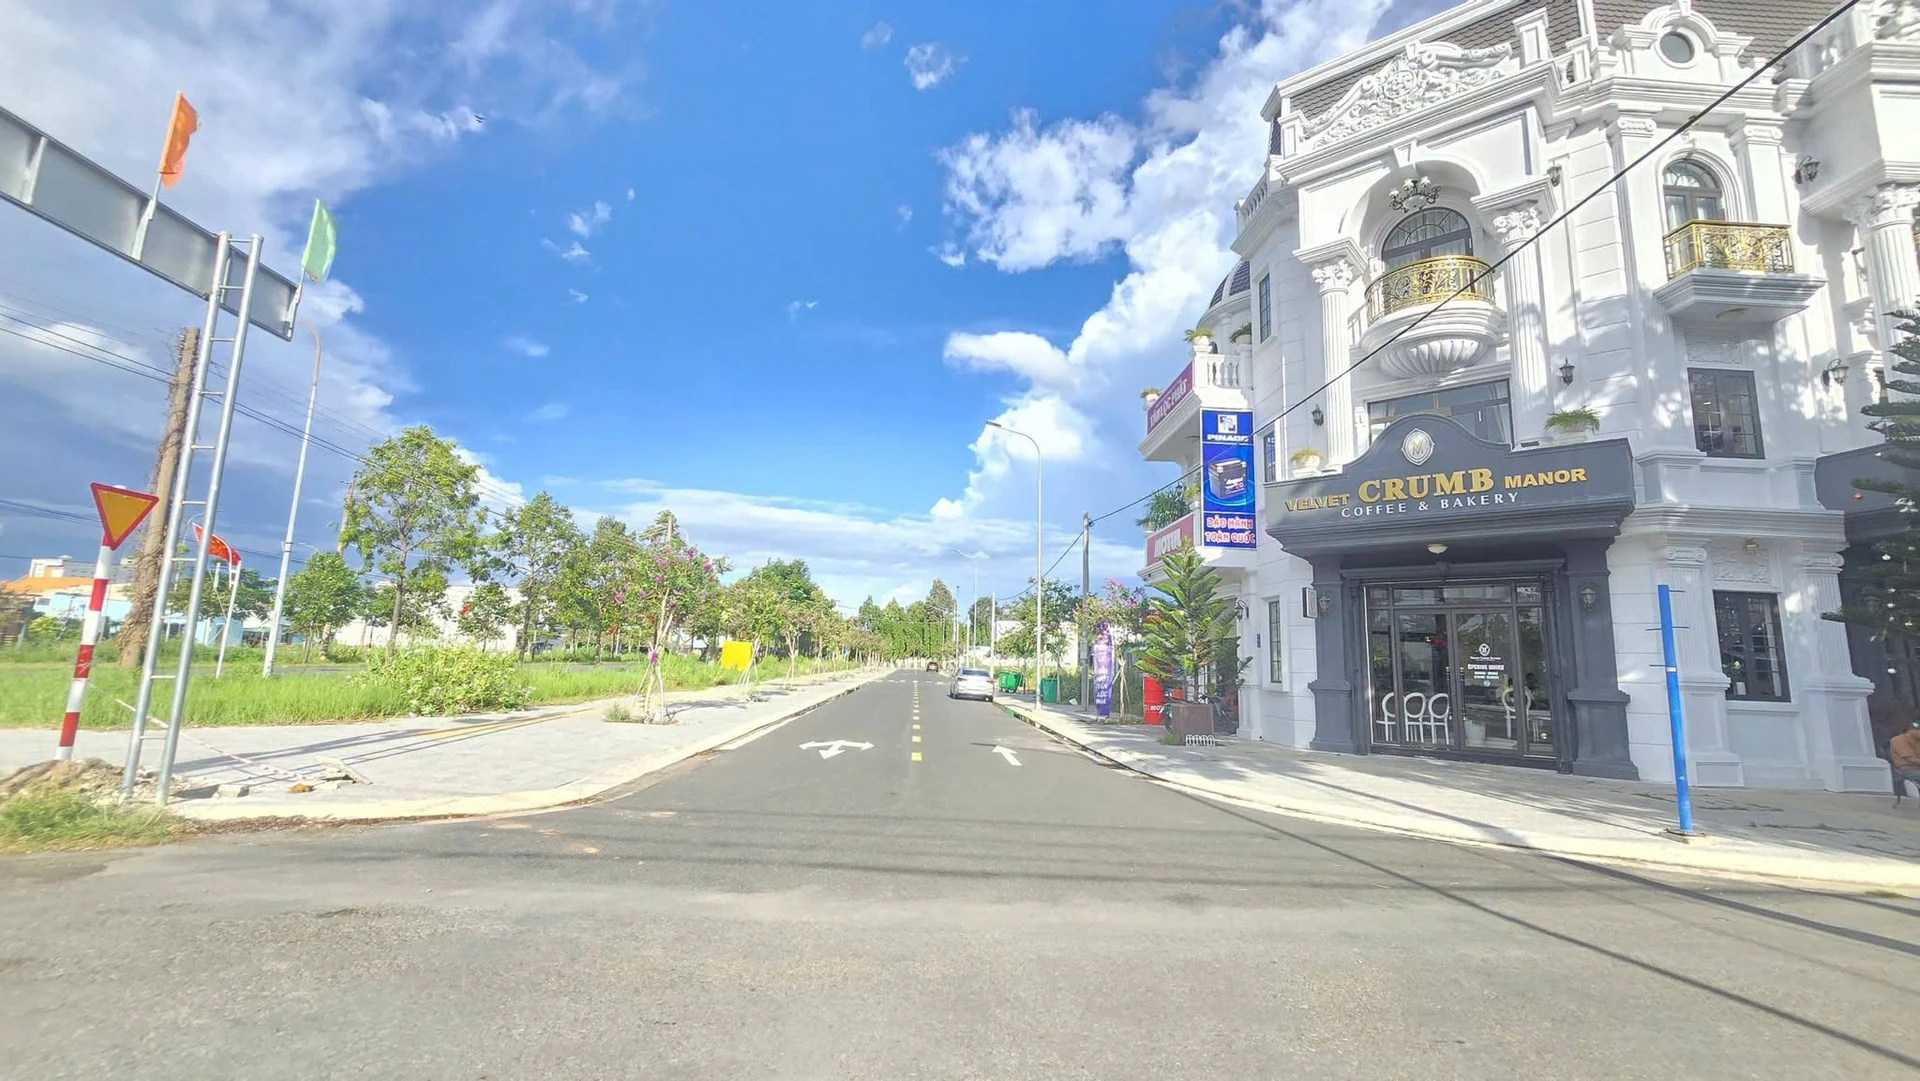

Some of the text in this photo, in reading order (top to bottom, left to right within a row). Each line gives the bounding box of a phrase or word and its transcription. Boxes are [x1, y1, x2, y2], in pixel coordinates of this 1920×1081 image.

[1285, 467, 1587, 511] VELVET CRUMB MANOR
[1341, 492, 1519, 518] COFFEE & BAKERY
[1206, 514, 1253, 530] BẢO HÀNH
[1204, 531, 1256, 544] TOÀN QUỐC
